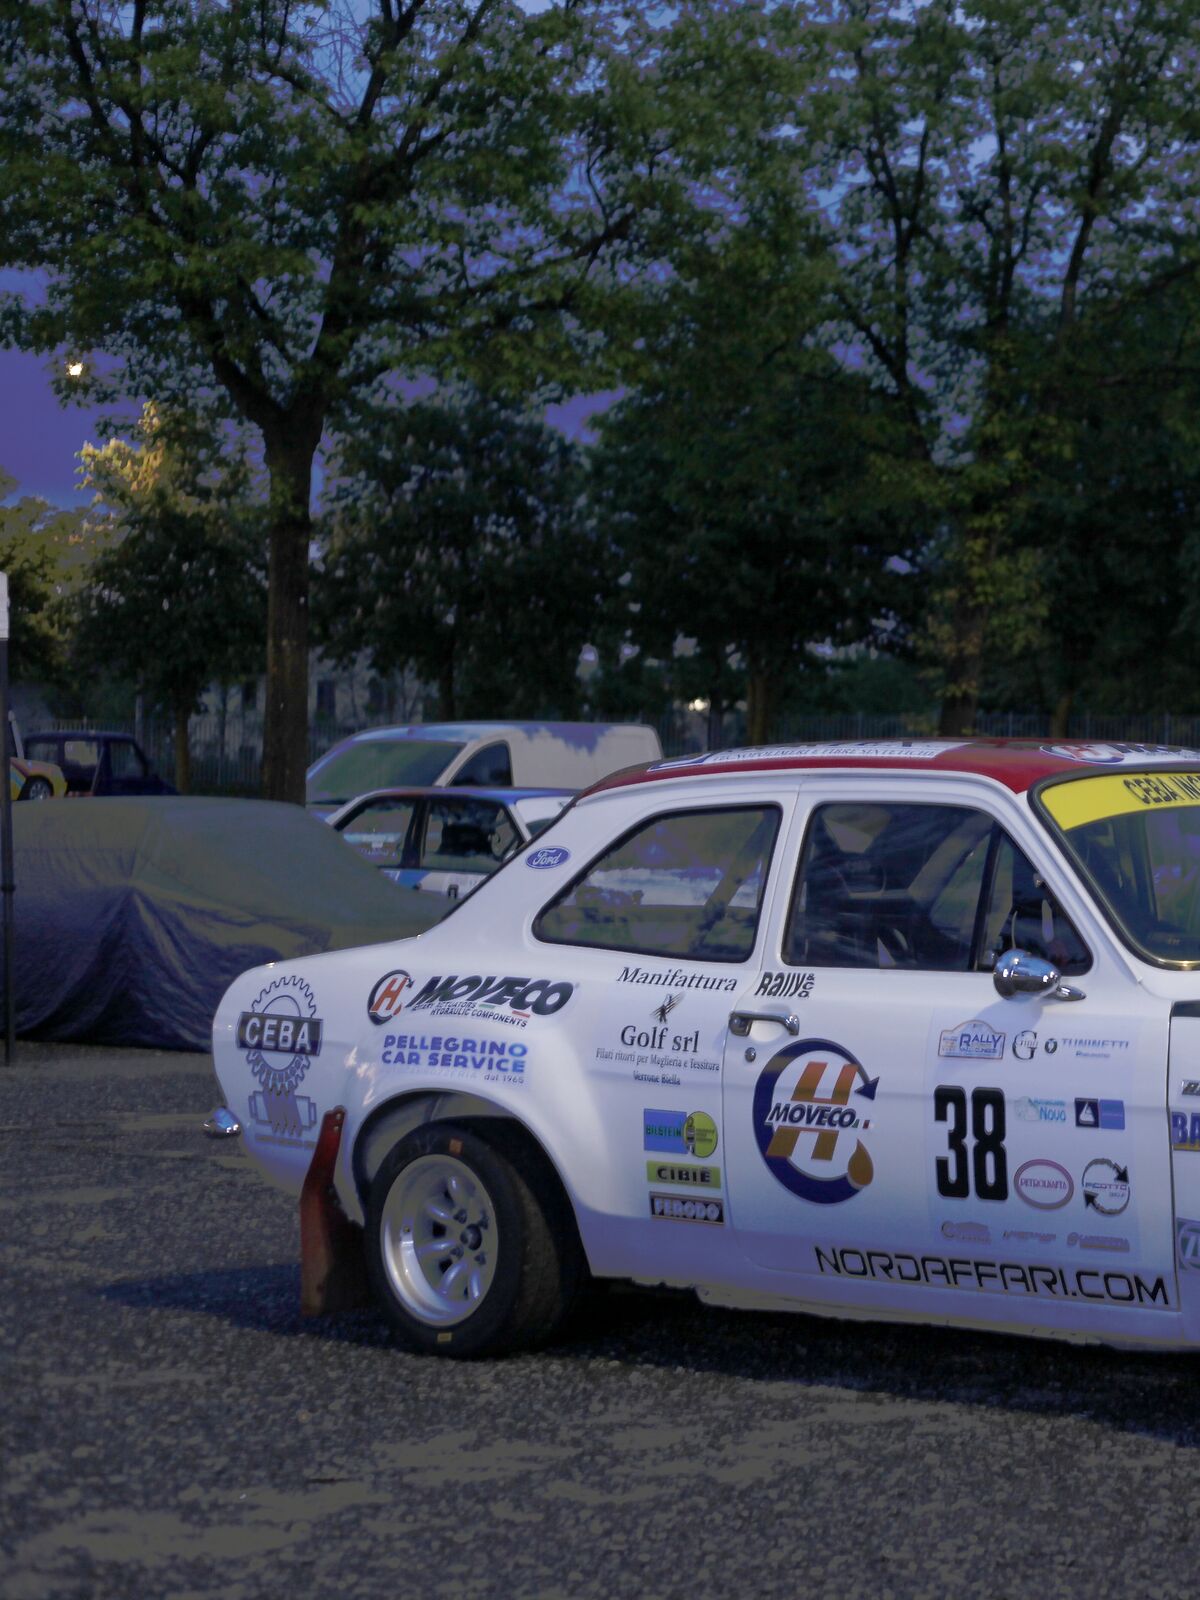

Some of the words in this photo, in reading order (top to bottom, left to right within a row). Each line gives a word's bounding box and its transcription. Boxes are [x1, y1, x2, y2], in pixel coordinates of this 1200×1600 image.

[533, 849, 562, 865] Ford
[616, 966, 738, 991] Manifattura
[405, 975, 576, 1016] MOVECO
[430, 1008, 471, 1017] HYDRAULIC
[471, 1010, 528, 1028] COMPONENTS
[244, 1018, 311, 1052] CEBA
[384, 1034, 528, 1058] PELLEGRINO
[621, 1025, 668, 1050] Golf
[671, 1030, 700, 1053] srl
[960, 1033, 1003, 1049] RALLY
[381, 1051, 421, 1066] CAR
[428, 1052, 526, 1073] SERVICE
[637, 1054, 649, 1067] per
[768, 1102, 858, 1128] MOVECO
[934, 1084, 1009, 1202] 38
[814, 1245, 1170, 1306] NORDAFFARI.COM
